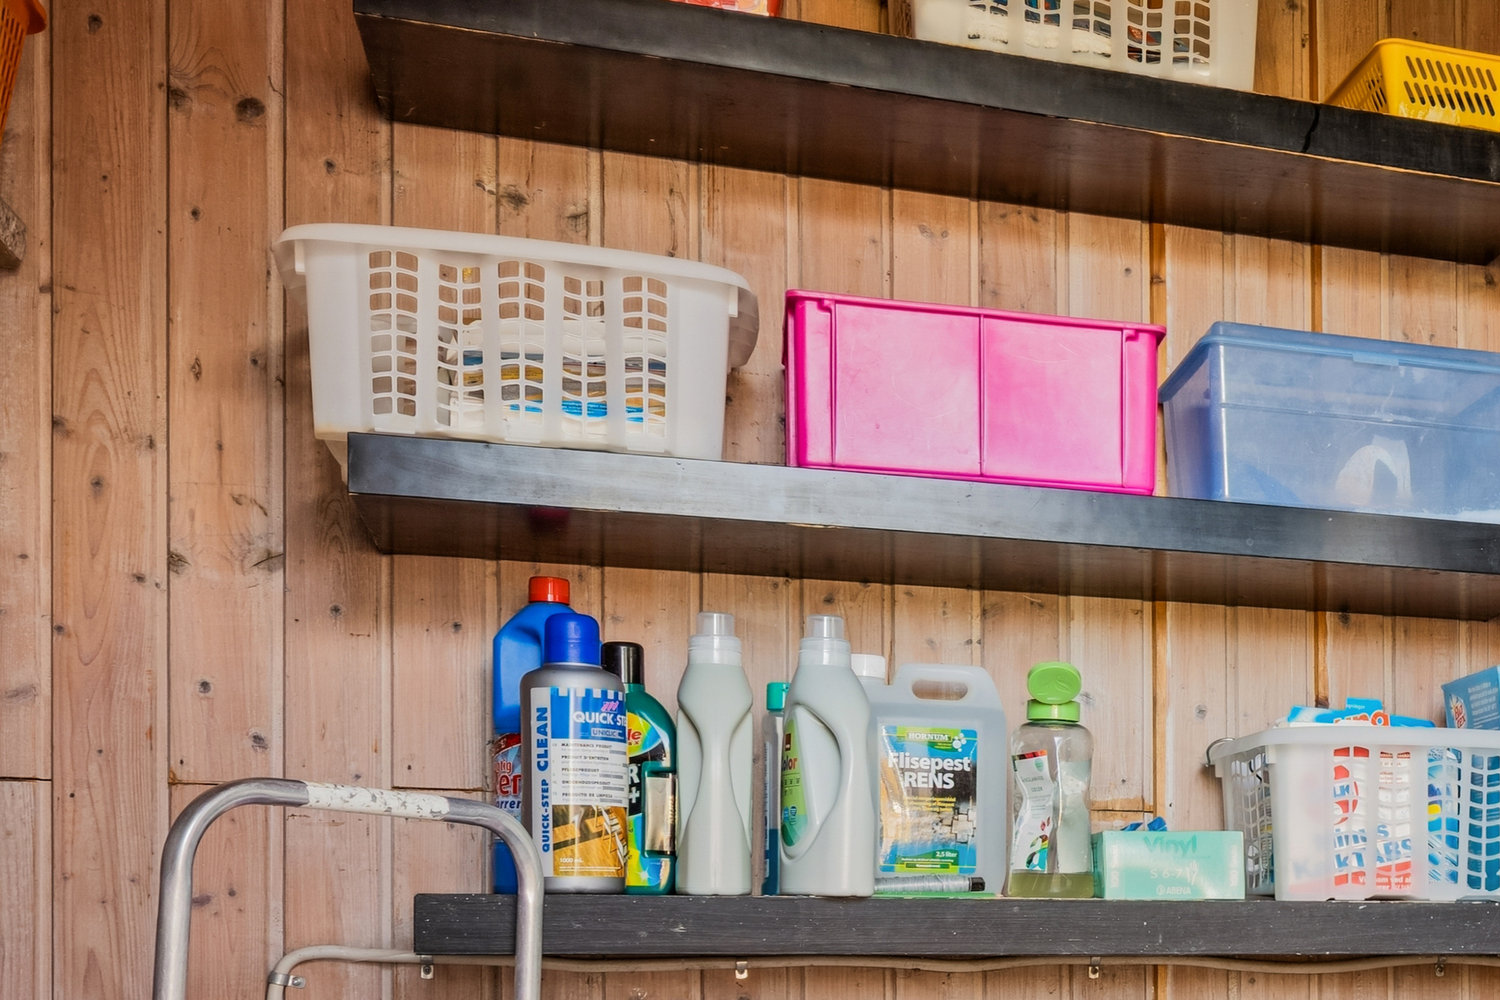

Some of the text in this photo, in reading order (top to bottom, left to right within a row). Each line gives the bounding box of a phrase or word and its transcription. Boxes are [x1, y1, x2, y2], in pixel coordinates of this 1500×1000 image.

[908, 732, 949, 741] HORNUM
[888, 752, 971, 775] Flisepest
[536, 707, 551, 854] QUICK-STEP CLEAN
[1144, 834, 1197, 857] Vinyl
